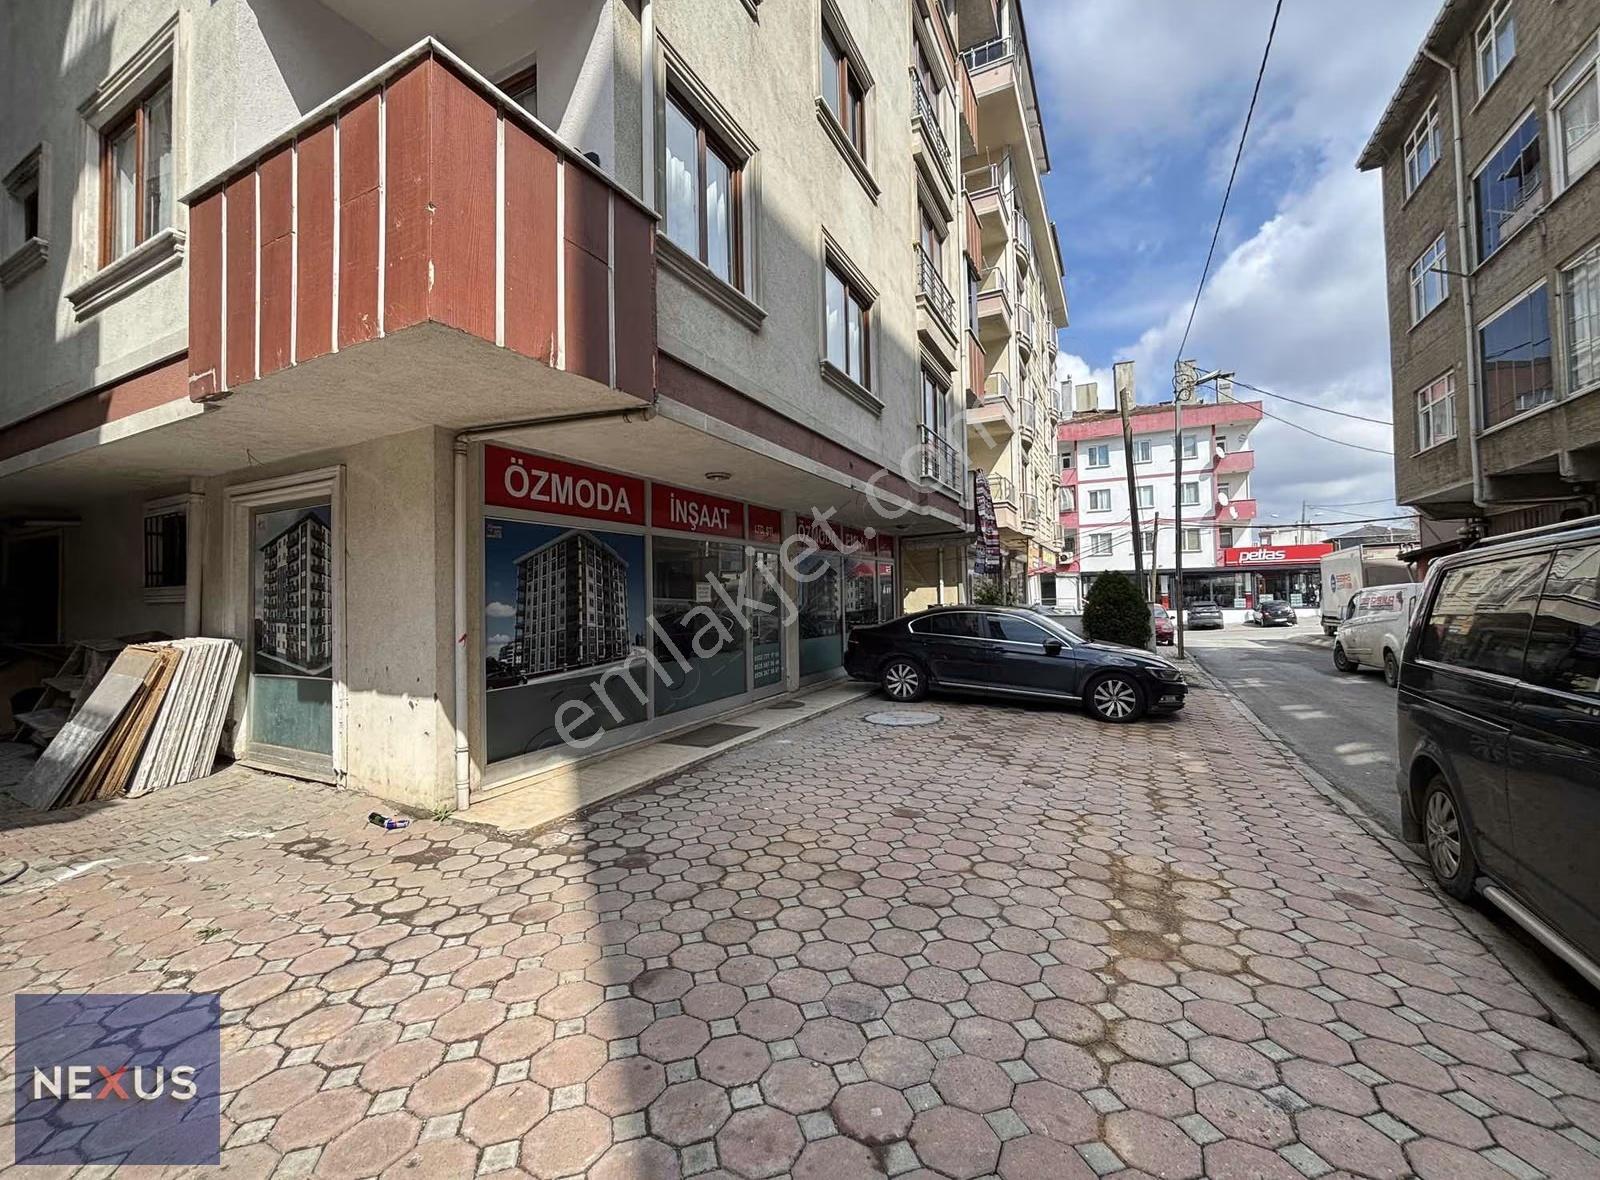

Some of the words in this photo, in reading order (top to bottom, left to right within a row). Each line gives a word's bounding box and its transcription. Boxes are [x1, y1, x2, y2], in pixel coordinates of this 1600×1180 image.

[504, 457, 632, 515] ÖZMODA
[670, 492, 730, 531] İNŞAAT
[798, 520, 837, 548] ÖZMOD
[1239, 548, 1286, 563] petlas
